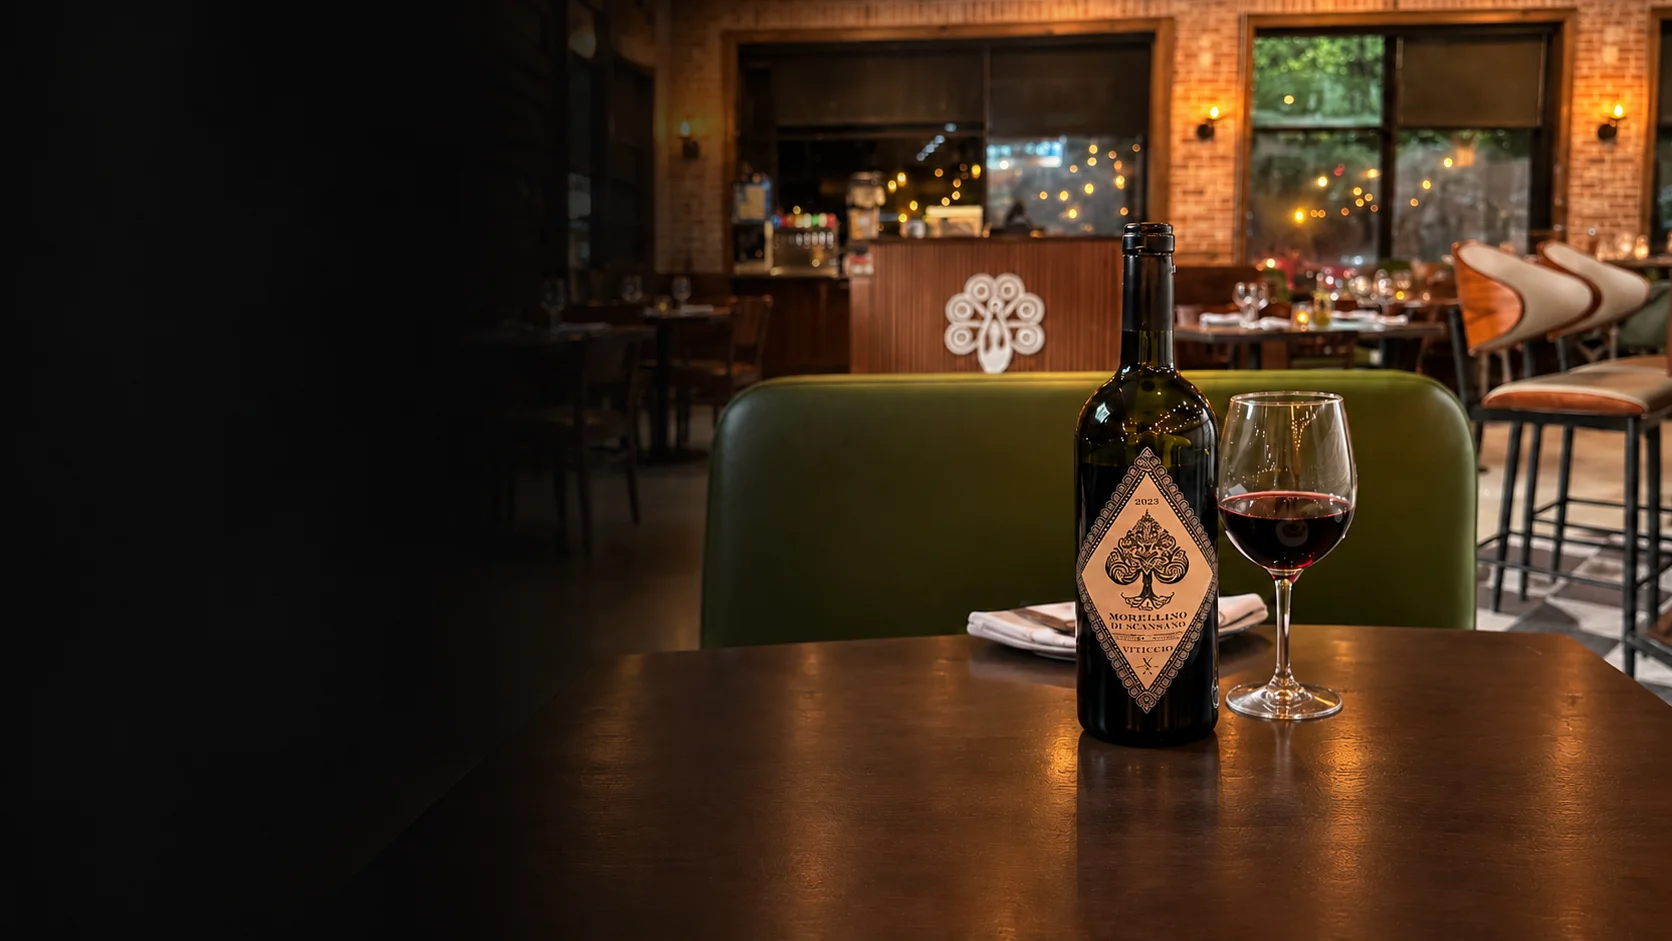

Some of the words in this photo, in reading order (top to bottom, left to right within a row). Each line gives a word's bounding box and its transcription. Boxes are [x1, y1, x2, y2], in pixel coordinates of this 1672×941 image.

[1134, 498, 1160, 506] 2023
[1109, 611, 1188, 622] MORELLINO
[1111, 622, 1122, 630] DI
[1126, 621, 1186, 631] SCANSANO
[1122, 645, 1174, 654] VITICCIO
